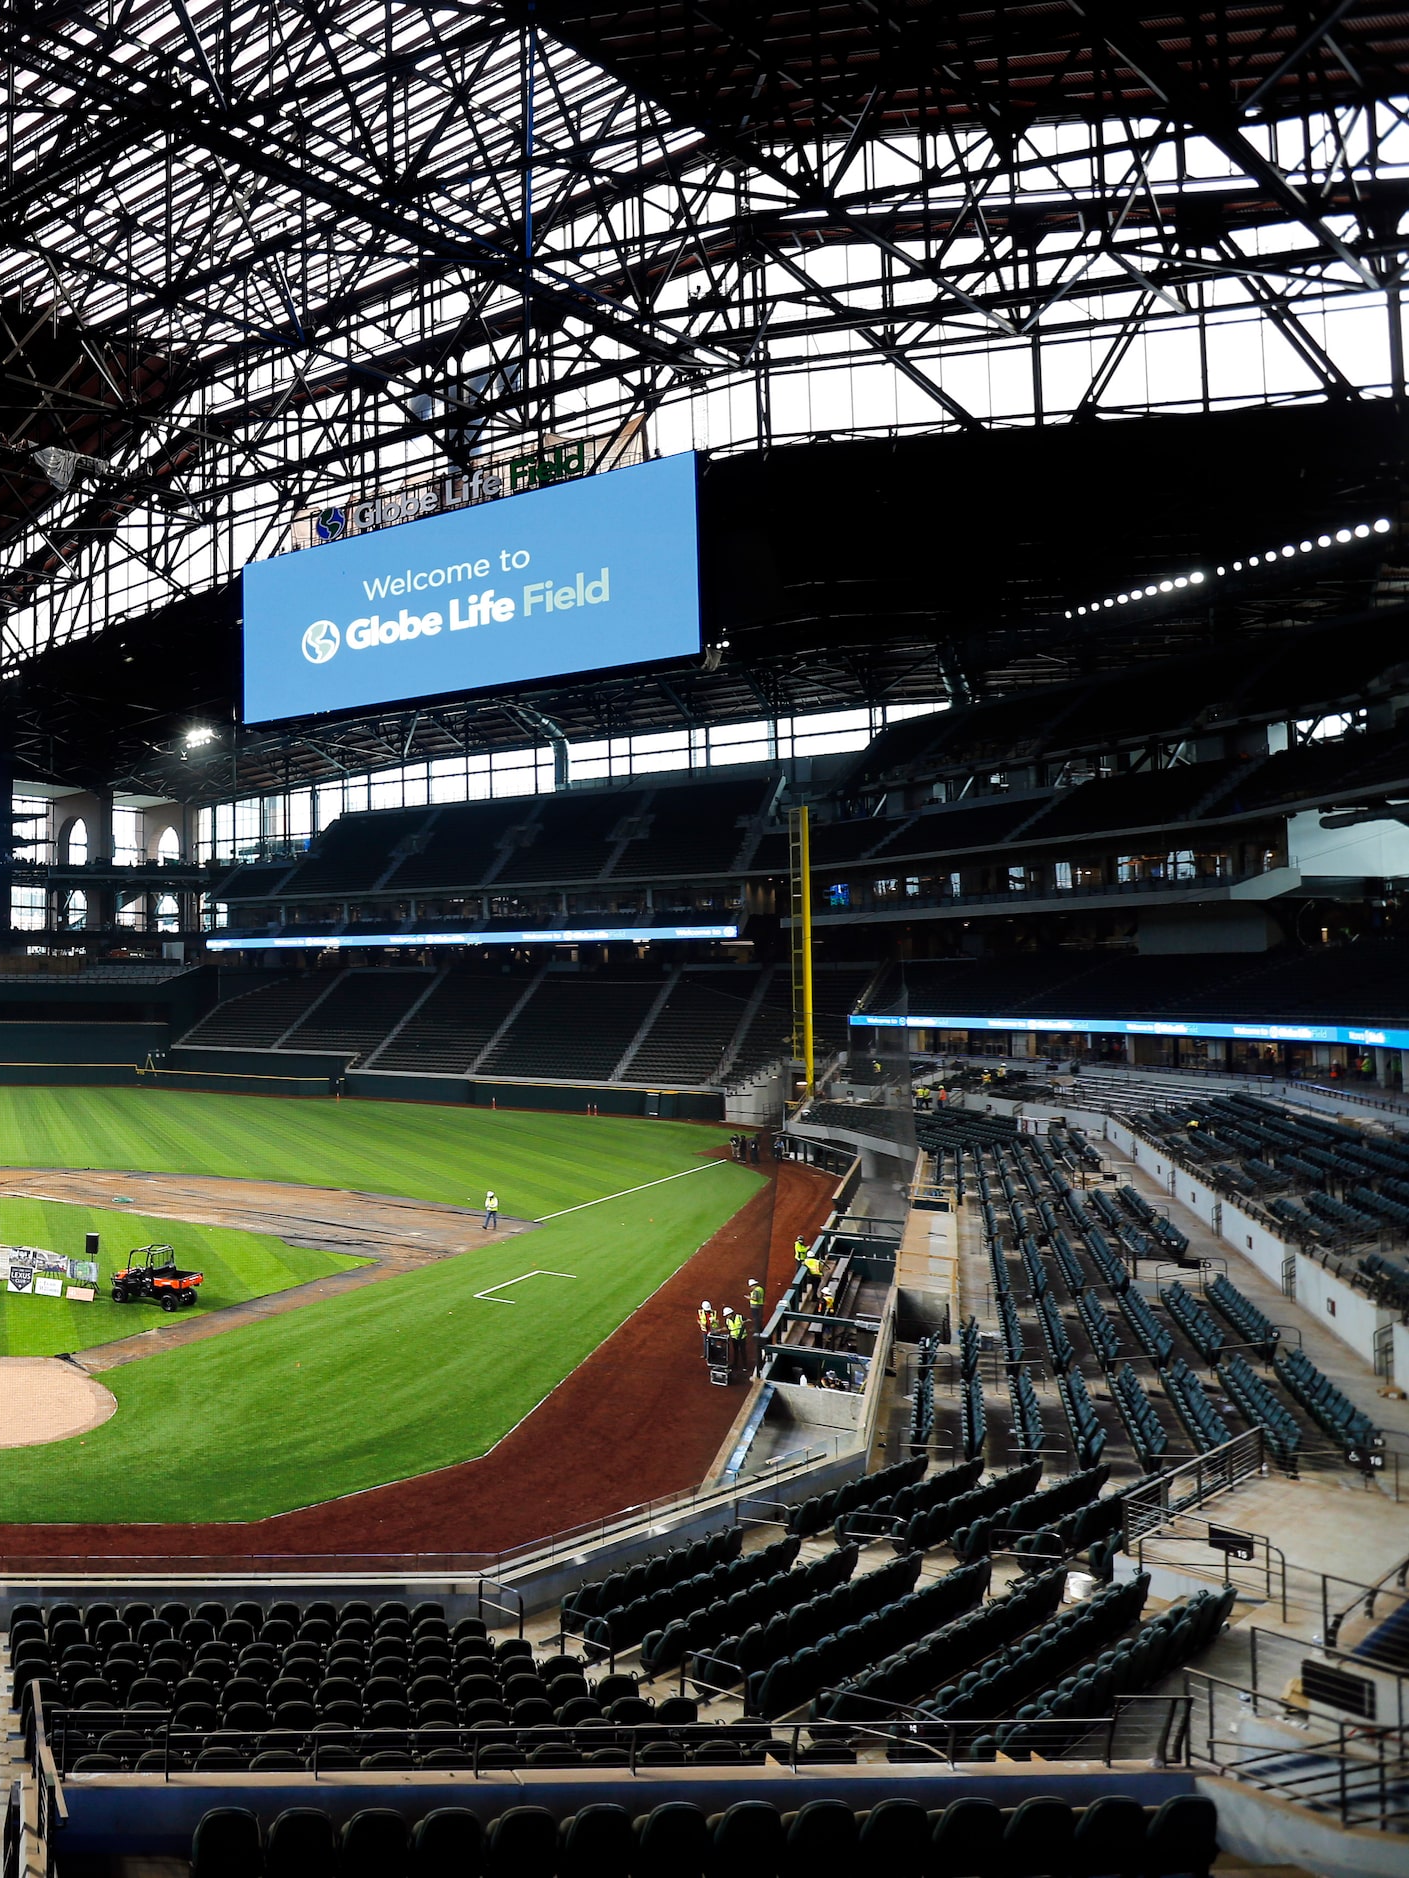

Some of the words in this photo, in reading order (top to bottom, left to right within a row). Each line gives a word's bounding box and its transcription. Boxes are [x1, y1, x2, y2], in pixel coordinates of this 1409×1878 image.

[354, 490, 439, 530] Globe
[445, 469, 502, 507] Life
[510, 442, 585, 490] Field
[363, 555, 491, 601] Welcome
[499, 548, 531, 574] to
[345, 610, 443, 651] Globe
[449, 589, 515, 632] Life
[523, 567, 610, 617] Field
[11, 1271, 32, 1281] LEXUS
[1236, 1549, 1248, 1560] 15
